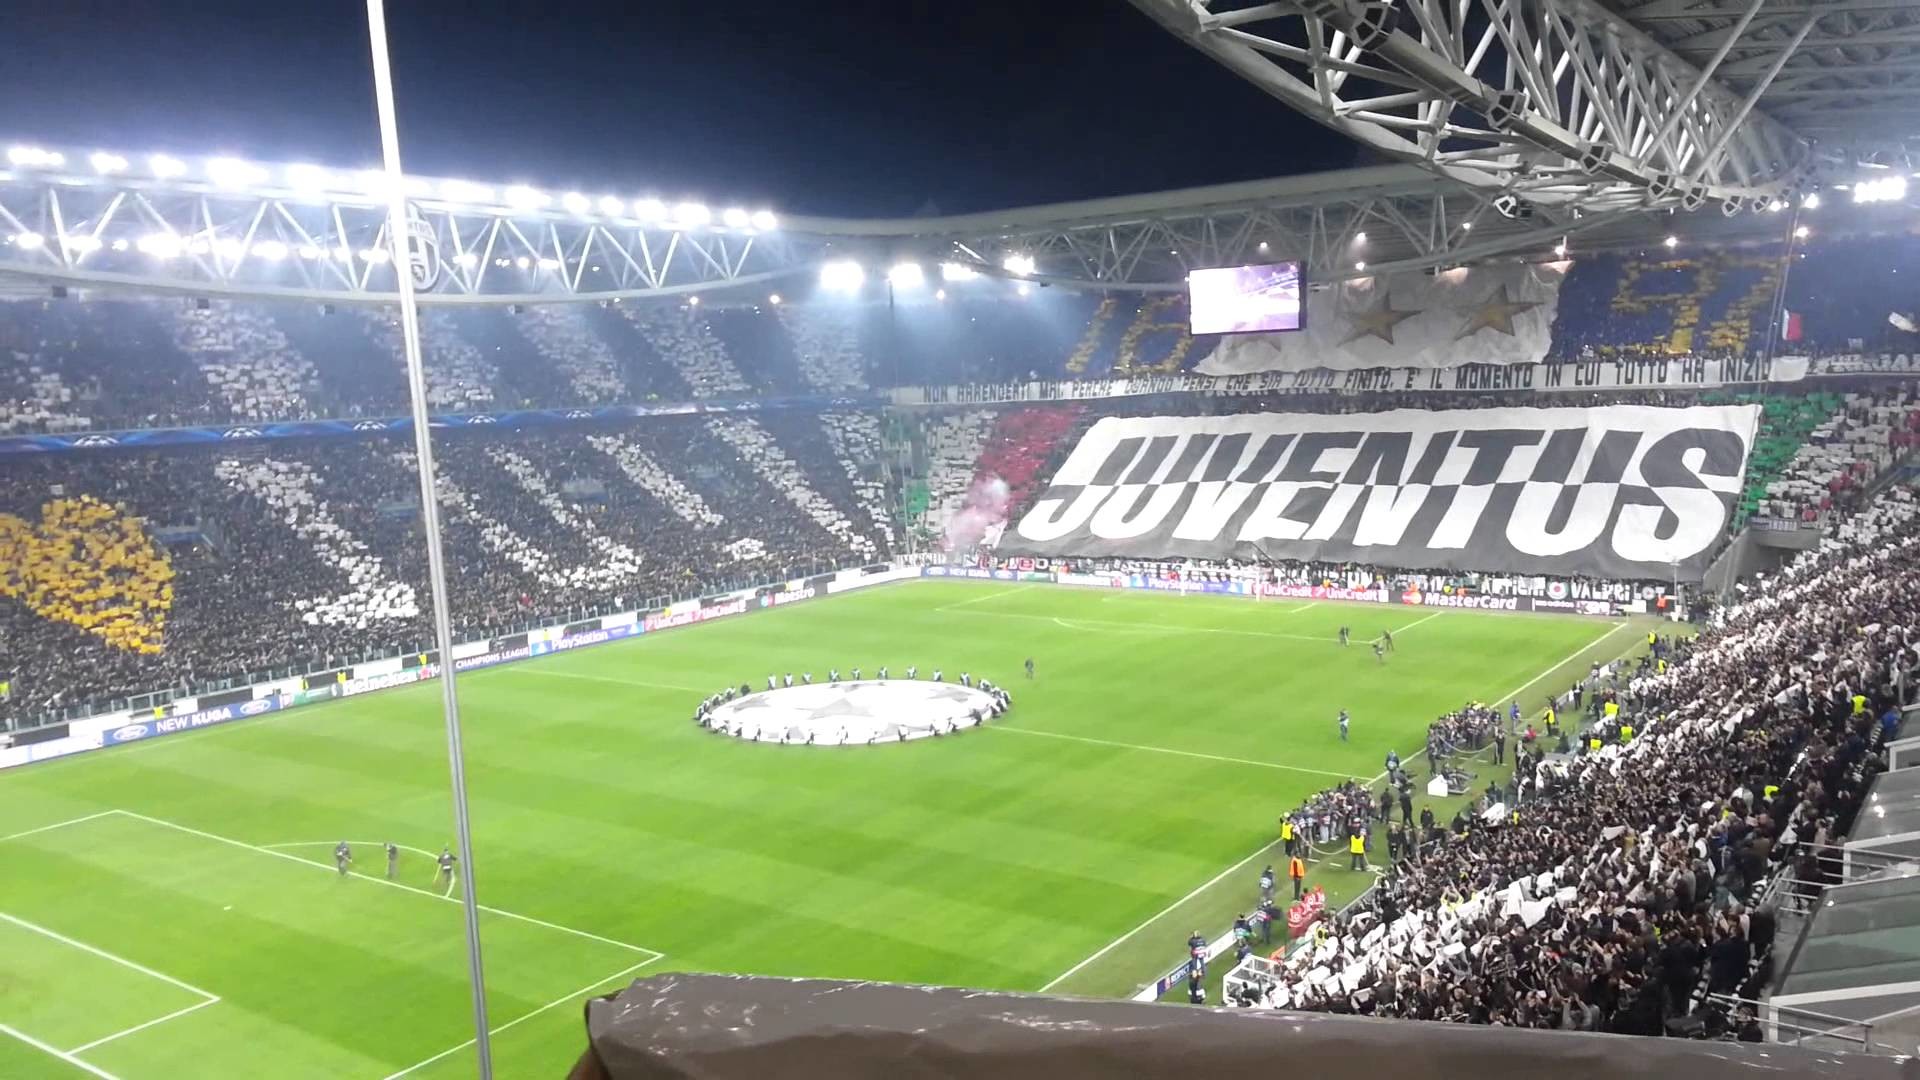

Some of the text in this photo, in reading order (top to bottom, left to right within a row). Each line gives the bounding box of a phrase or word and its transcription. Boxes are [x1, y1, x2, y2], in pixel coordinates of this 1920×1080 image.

[923, 385, 948, 401] NON
[1226, 375, 1249, 390] CHE
[1259, 374, 1281, 388] SIA
[1431, 368, 1443, 389] IL
[1456, 364, 1534, 389] MOMENTO
[1545, 364, 1562, 387] IN
[1574, 362, 1601, 386] CUI
[1616, 360, 1668, 385] TUTTO
[1682, 359, 1704, 383] HA
[1018, 427, 1743, 562] JUVENTUS
[1263, 583, 1313, 598] UniCredit
[1425, 592, 1517, 610] MasterCard
[551, 629, 609, 650] PlayStation
[455, 652, 500, 671] CHAMPIONS
[502, 645, 530, 660] LEAGUE
[156, 707, 233, 735] NEW KUGA
